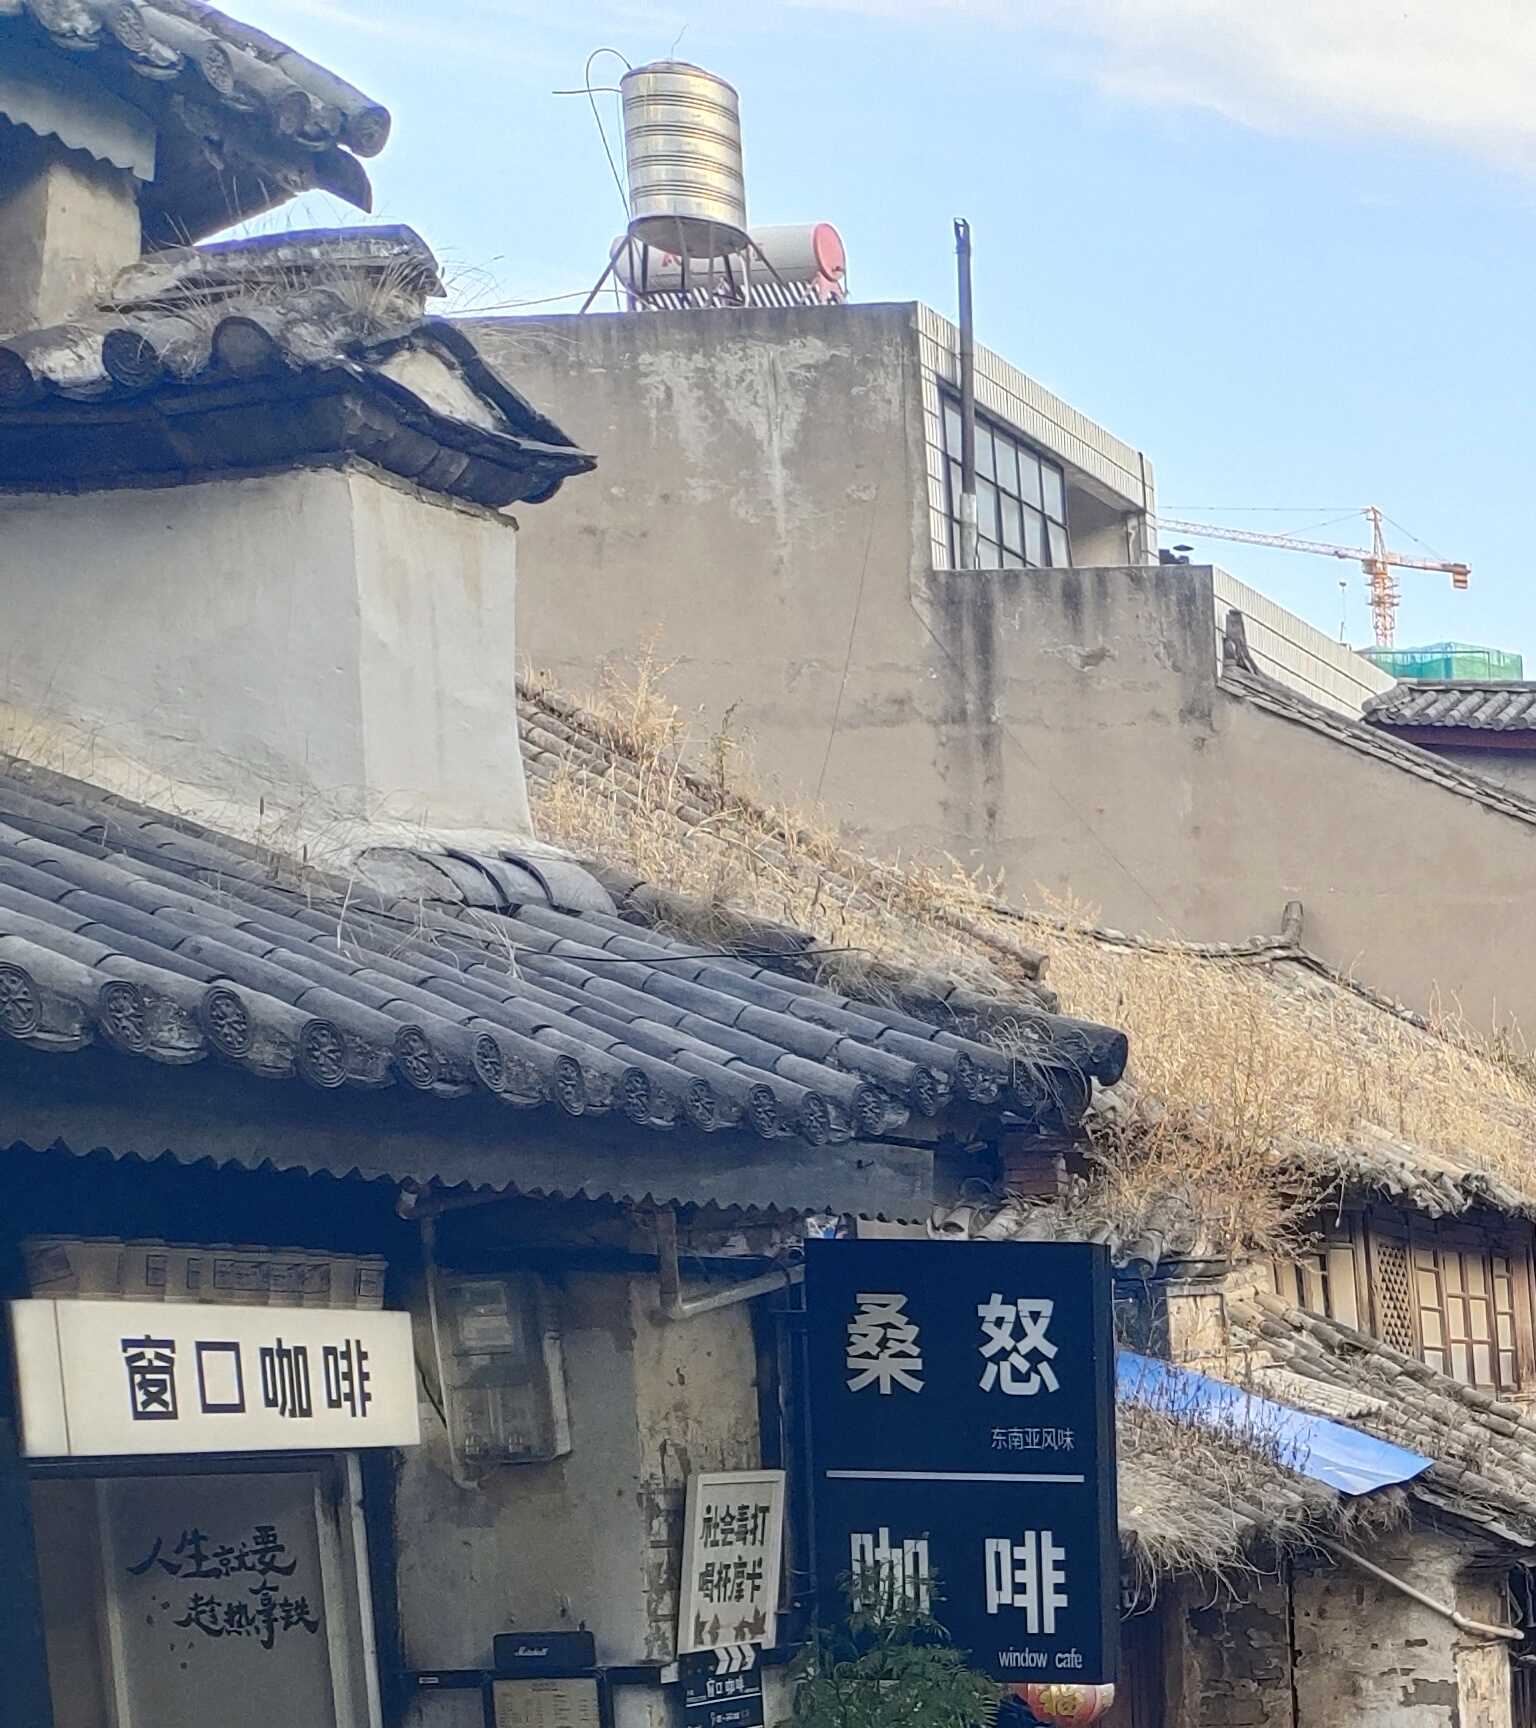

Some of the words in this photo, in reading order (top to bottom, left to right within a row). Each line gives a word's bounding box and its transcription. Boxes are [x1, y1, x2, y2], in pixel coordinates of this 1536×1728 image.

[846, 1292, 1060, 1396] 桑怒
[120, 1334, 372, 1421] 窗口咖啡
[991, 1428, 1075, 1451] 东南亚风味
[700, 1503, 770, 1548] 社会毒打
[126, 1525, 297, 1579] 人生就要
[698, 1554, 763, 1603] 喝杯摩卡
[850, 1526, 1069, 1634] 咖啡
[998, 1648, 1048, 1668] window
[1055, 1648, 1083, 1669] cafe
